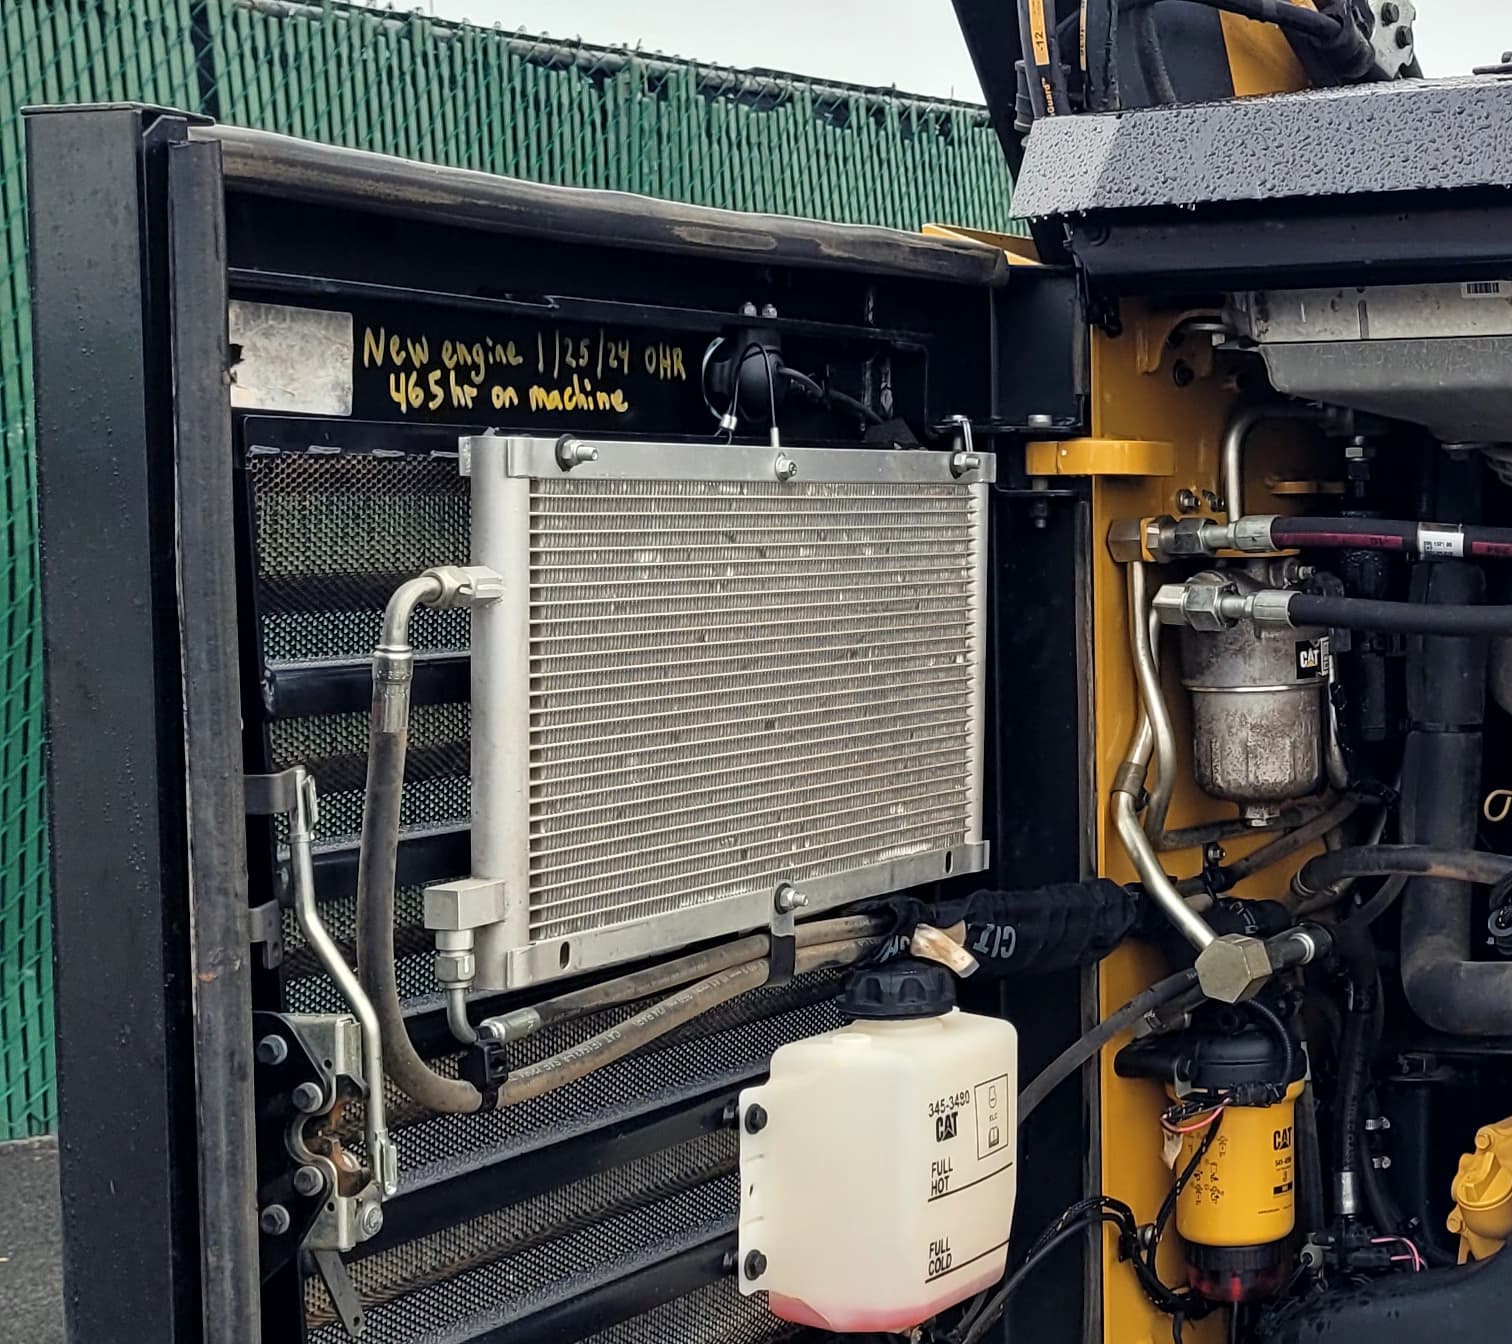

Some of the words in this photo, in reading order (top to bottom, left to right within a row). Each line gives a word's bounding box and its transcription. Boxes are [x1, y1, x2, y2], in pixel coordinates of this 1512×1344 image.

[363, 325, 430, 369] New
[441, 336, 524, 385] engine
[491, 384, 519, 410] on
[529, 373, 629, 413] machine
[1299, 647, 1320, 668] CAT
[936, 1111, 958, 1143] CAT
[1273, 1126, 1293, 1151] CAT
[931, 1156, 954, 1178] FULL
[930, 1175, 950, 1197] HOT
[928, 1236, 951, 1260] FULL
[928, 1253, 953, 1276] COLD
